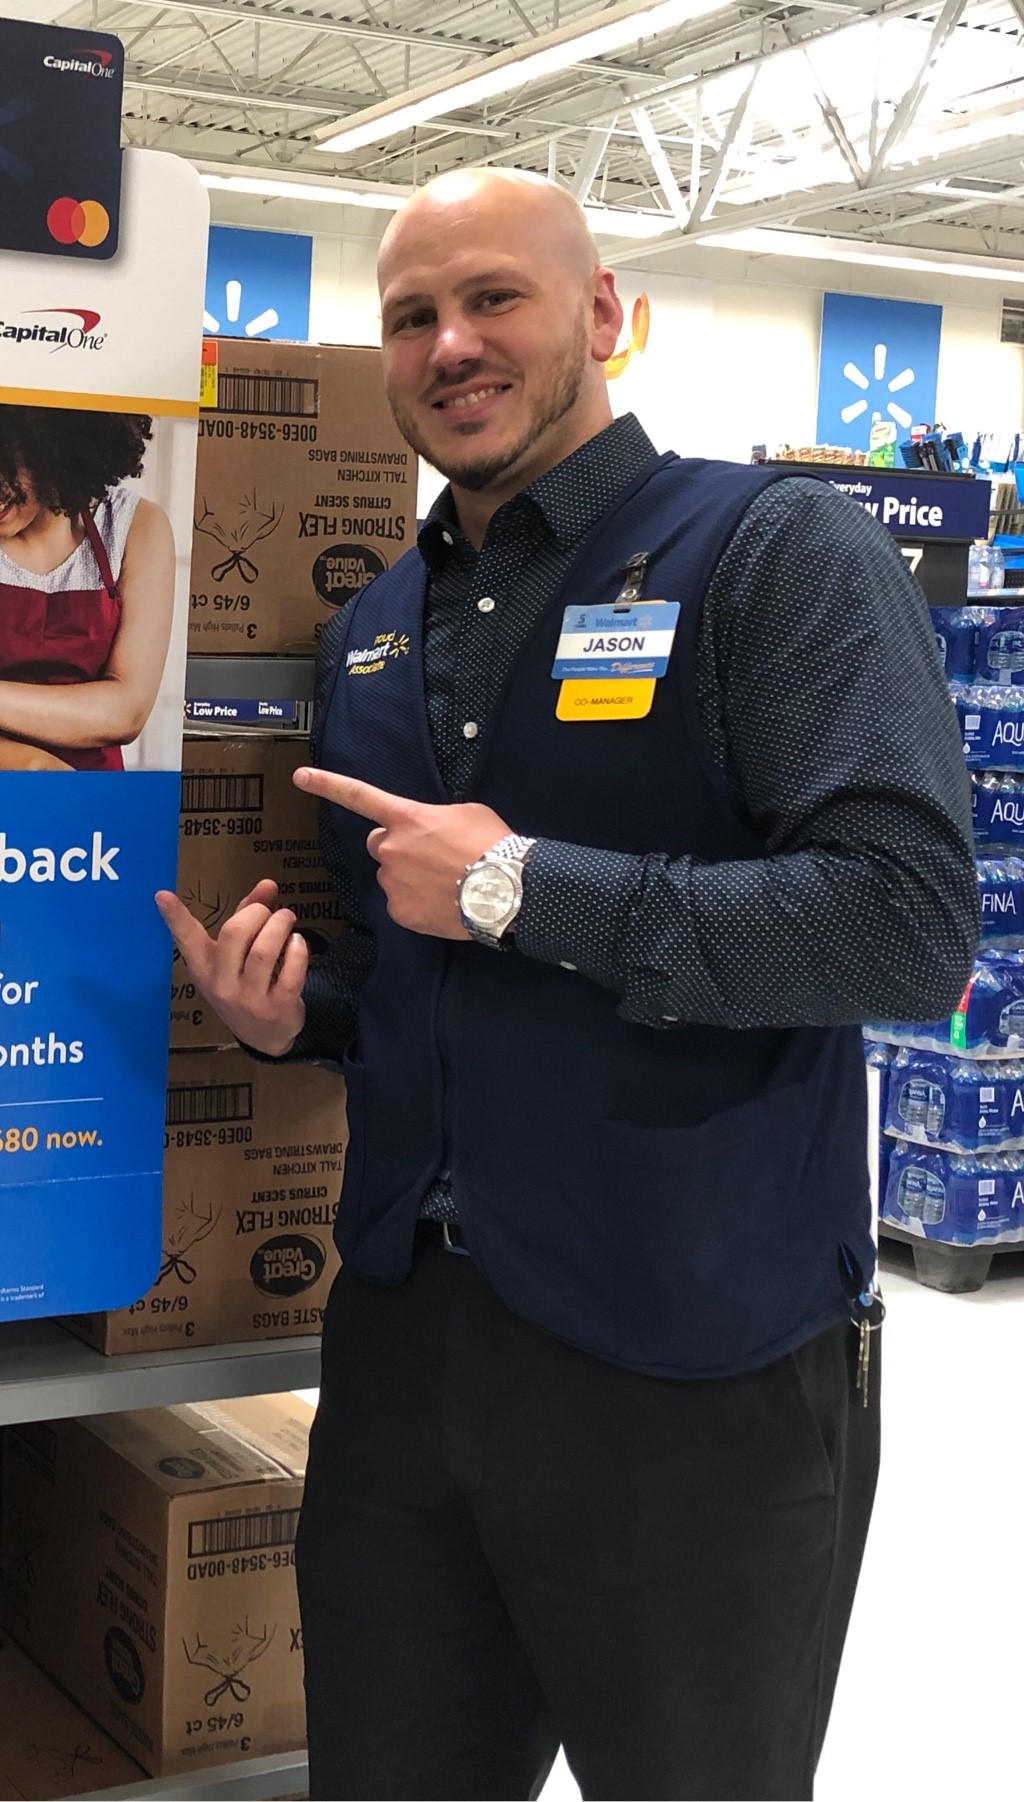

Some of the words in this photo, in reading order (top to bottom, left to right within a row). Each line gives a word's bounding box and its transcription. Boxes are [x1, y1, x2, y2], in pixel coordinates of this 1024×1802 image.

[308, 449, 336, 462] BAGS
[339, 450, 407, 465] DRAWSTRING
[337, 469, 379, 483] KITCHEN
[382, 470, 407, 484] TALL
[314, 495, 349, 508] SCENT
[352, 496, 391, 509] CITRUS
[882, 496, 944, 528] Price
[298, 512, 337, 539] FLEX
[340, 515, 405, 541] STRONG
[326, 557, 366, 573] Value
[191, 594, 208, 610] ct
[213, 594, 250, 611] 6/45
[578, 614, 586, 624] 5
[596, 617, 638, 628] Walmart
[246, 623, 257, 639] 3
[583, 636, 646, 653] JASON
[346, 641, 390, 667] Walmart
[574, 696, 634, 706] CO-MANAGER
[193, 706, 214, 716] Low
[214, 706, 238, 717] Price
[258, 706, 269, 715] Low
[269, 706, 283, 716] Price
[253, 840, 283, 852] BAGS
[192, 1010, 203, 1024] 3
[46, 1128, 103, 1149] now.
[244, 1145, 272, 1160] BAGS
[275, 1143, 342, 1158] DRAWSTRING
[273, 1161, 317, 1175] KITCHEN
[318, 1160, 342, 1172] TALL
[252, 1190, 286, 1204] SCENT
[289, 1186, 327, 1199] CITRUS
[235, 1209, 274, 1236] FLEX
[263, 1248, 304, 1262] Value
[263, 1259, 316, 1283] Great
[21, 1283, 44, 1293] Standard
[10, 1293, 38, 1302] trademark
[39, 1291, 45, 1299] of
[150, 1295, 188, 1314] 6/45
[253, 1309, 289, 1330] BAGS
[185, 1322, 195, 1337] 3
[186, 1719, 203, 1735] ct
[207, 1711, 244, 1732] 6/45
[240, 1736, 251, 1751] 3
